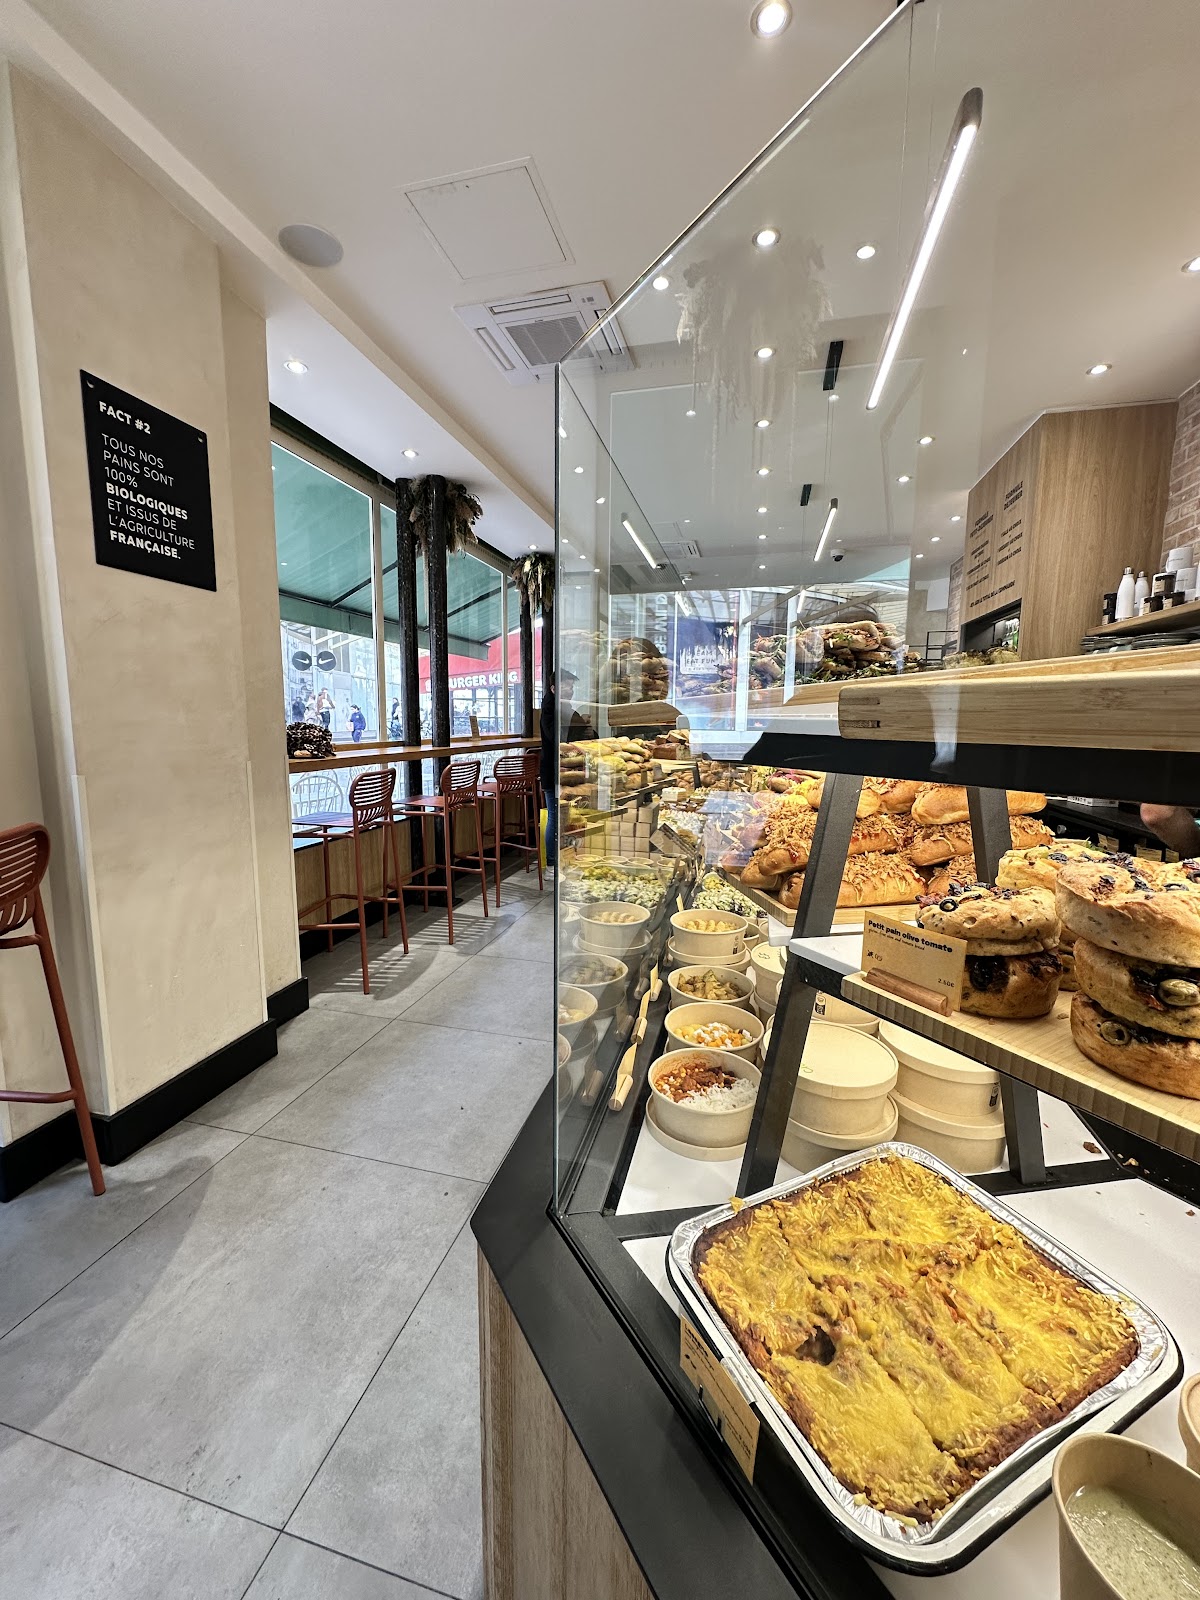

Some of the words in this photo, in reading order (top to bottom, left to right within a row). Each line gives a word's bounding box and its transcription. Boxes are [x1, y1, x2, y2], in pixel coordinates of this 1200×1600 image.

[99, 401, 132, 425] FACT
[134, 418, 152, 435] #2
[101, 433, 136, 458] TOUS
[139, 450, 165, 470] NOS
[103, 450, 141, 475] PAINS
[143, 466, 175, 487] SONT
[104, 466, 138, 488] 100%
[106, 482, 188, 520] BIOLOGIQUES
[107, 498, 122, 513] ET
[125, 502, 160, 526] ISSUS
[162, 516, 178, 531] DE
[108, 514, 196, 550] L'AGRICULTURE
[109, 530, 182, 560] FRANÇAISE.
[449, 674, 487, 689] URGER
[868, 919, 885, 931] Petit
[885, 925, 901, 937] pain
[901, 932, 920, 943] olive
[921, 938, 953, 953] tomate
